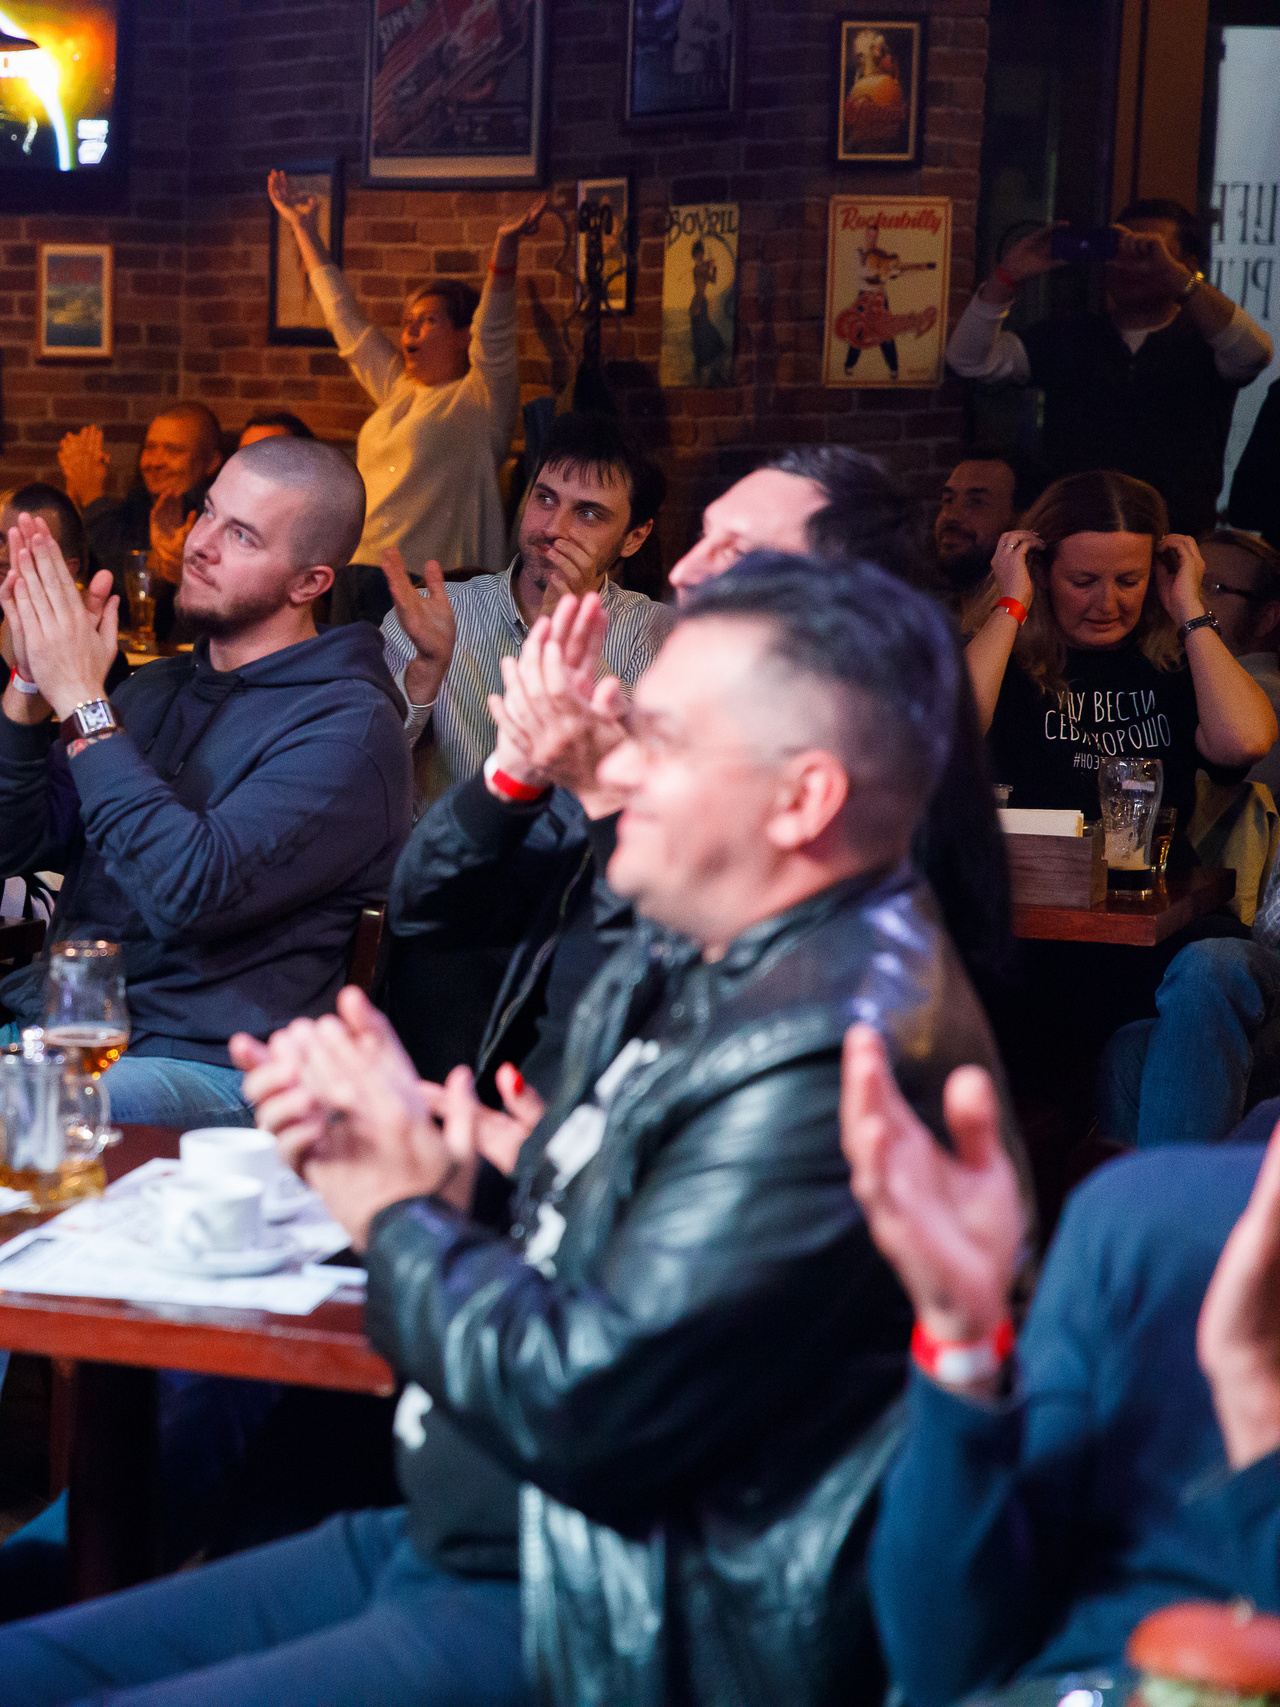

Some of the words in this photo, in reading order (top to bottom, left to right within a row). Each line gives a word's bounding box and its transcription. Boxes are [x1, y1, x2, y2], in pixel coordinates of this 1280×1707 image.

[664, 206, 739, 246] BOVRIL
[840, 206, 942, 235] Rockabilly
[1093, 689, 1156, 723] ВЕСТИ
[1091, 713, 1172, 756] ХОРОШО
[1073, 752, 1102, 770] #НОЭ
